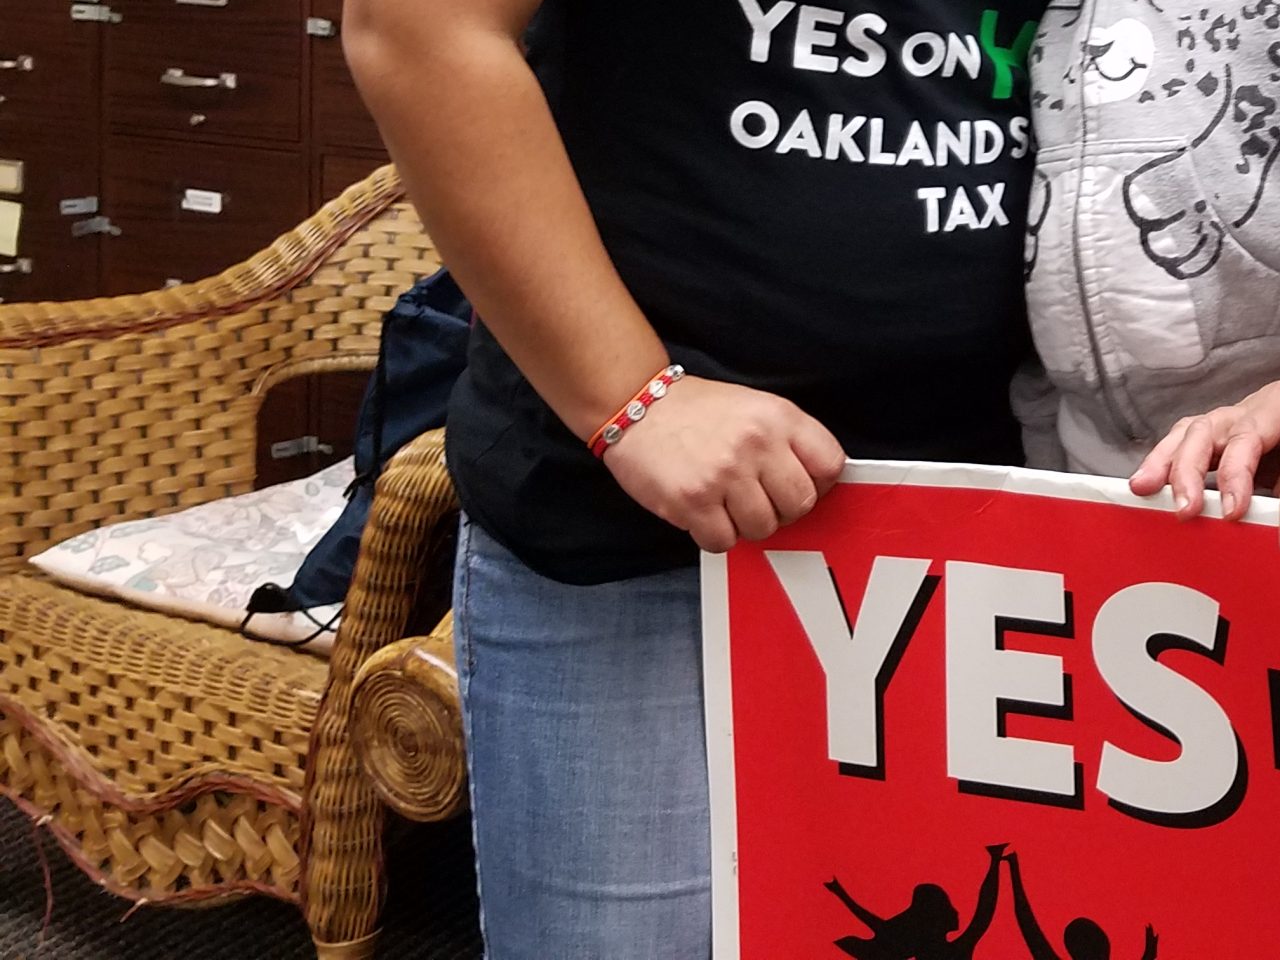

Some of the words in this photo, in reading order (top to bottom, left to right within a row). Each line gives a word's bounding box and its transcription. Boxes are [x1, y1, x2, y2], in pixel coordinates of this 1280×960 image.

[901, 31, 981, 79] ON
[730, 100, 1005, 166] OAKLAND
[917, 182, 1010, 233] TAX
[764, 550, 1246, 826] YES
